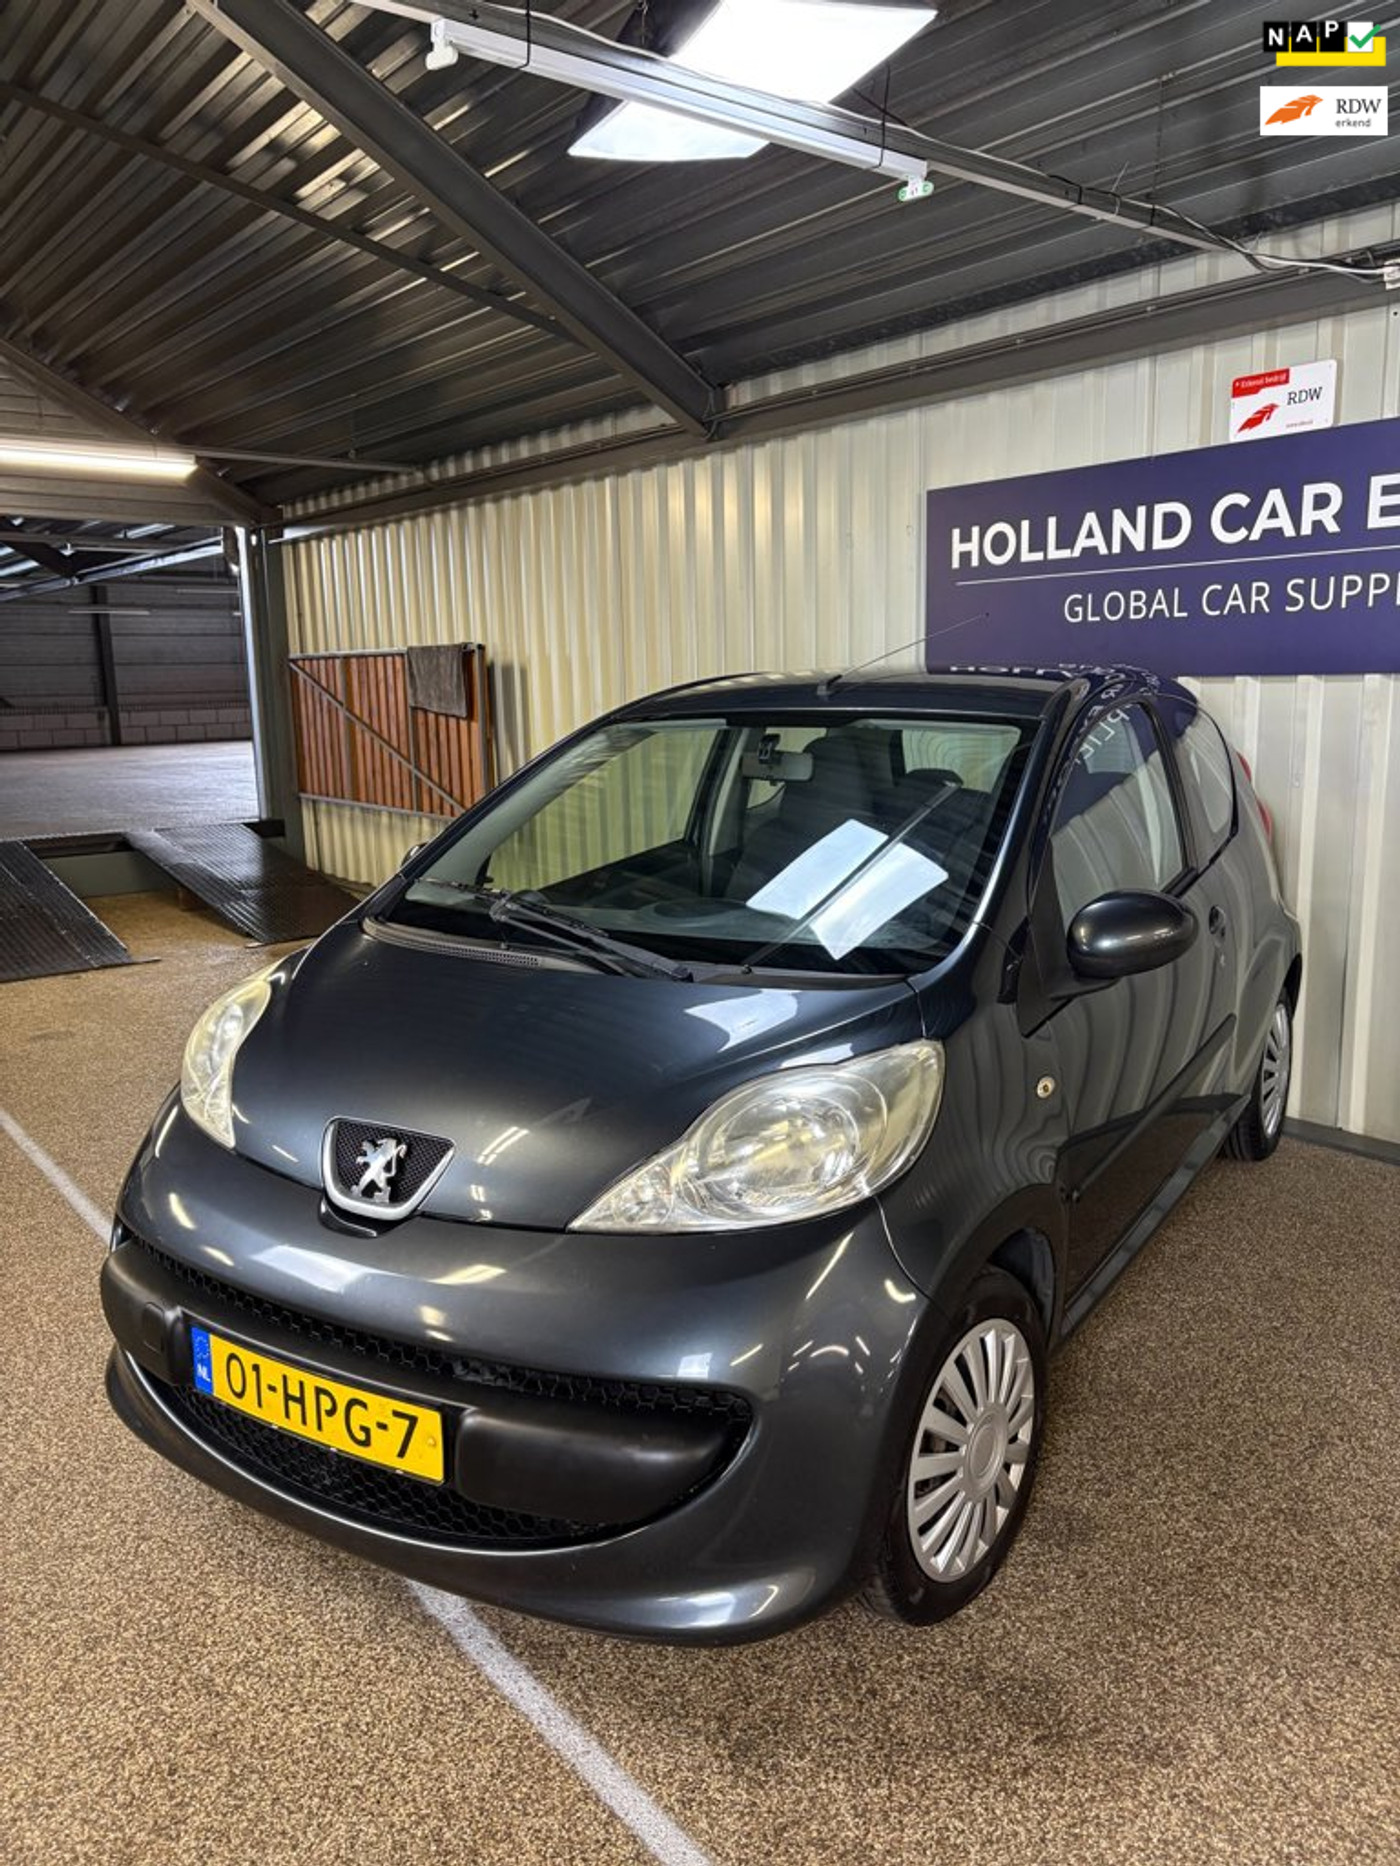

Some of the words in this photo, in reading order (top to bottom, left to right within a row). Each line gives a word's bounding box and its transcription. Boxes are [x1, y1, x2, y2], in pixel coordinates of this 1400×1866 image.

[1286, 387, 1323, 405] RDW
[951, 501, 1192, 569] HOLLAND
[1210, 482, 1343, 541] CAR
[1064, 587, 1188, 622] GLOBAL
[1202, 581, 1270, 616] CAR
[1285, 571, 1400, 612] SUPP
[196, 1363, 211, 1382] NL
[225, 1352, 419, 1459] 01-HPG-7
